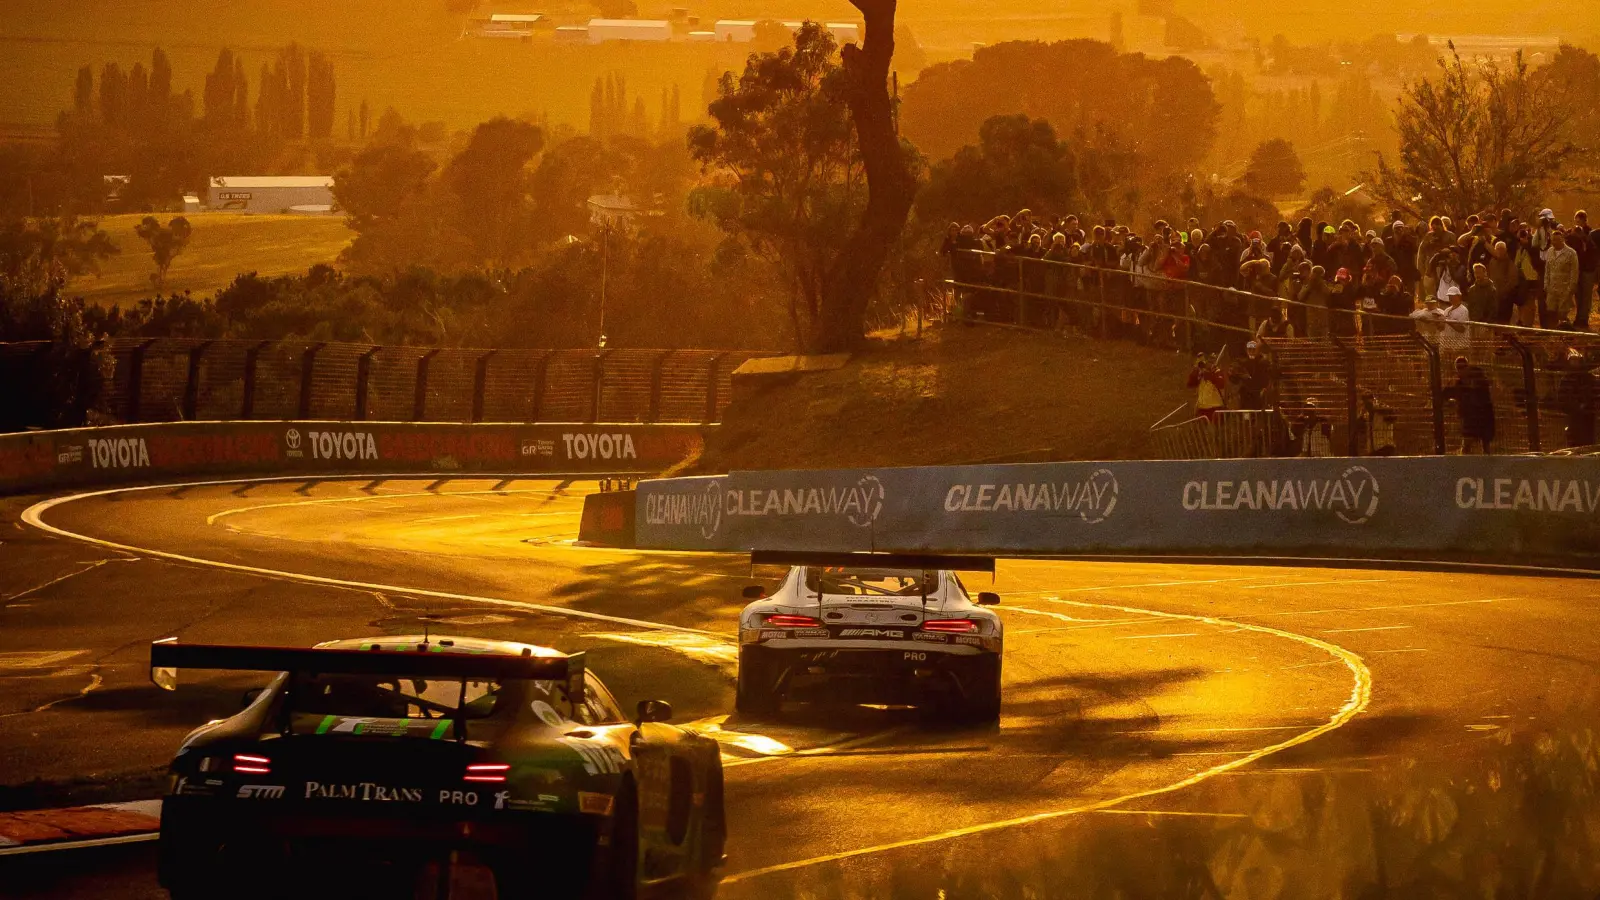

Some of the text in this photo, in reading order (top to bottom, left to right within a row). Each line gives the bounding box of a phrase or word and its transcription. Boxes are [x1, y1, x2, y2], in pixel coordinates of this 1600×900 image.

[88, 438, 150, 468] TOYOTA
[309, 431, 378, 460] TOYOTA
[562, 433, 637, 460] TOYOTA
[646, 492, 717, 525] CLEANAWAY
[727, 487, 875, 516] CLEANAWAY
[944, 481, 1110, 512] CLEANAWAY
[1182, 479, 1366, 511] CLEANAWAY
[761, 631, 787, 639] MOTUL
[956, 636, 981, 645] MOTUL
[904, 652, 927, 661] PRO
[439, 789, 478, 805] PRO
